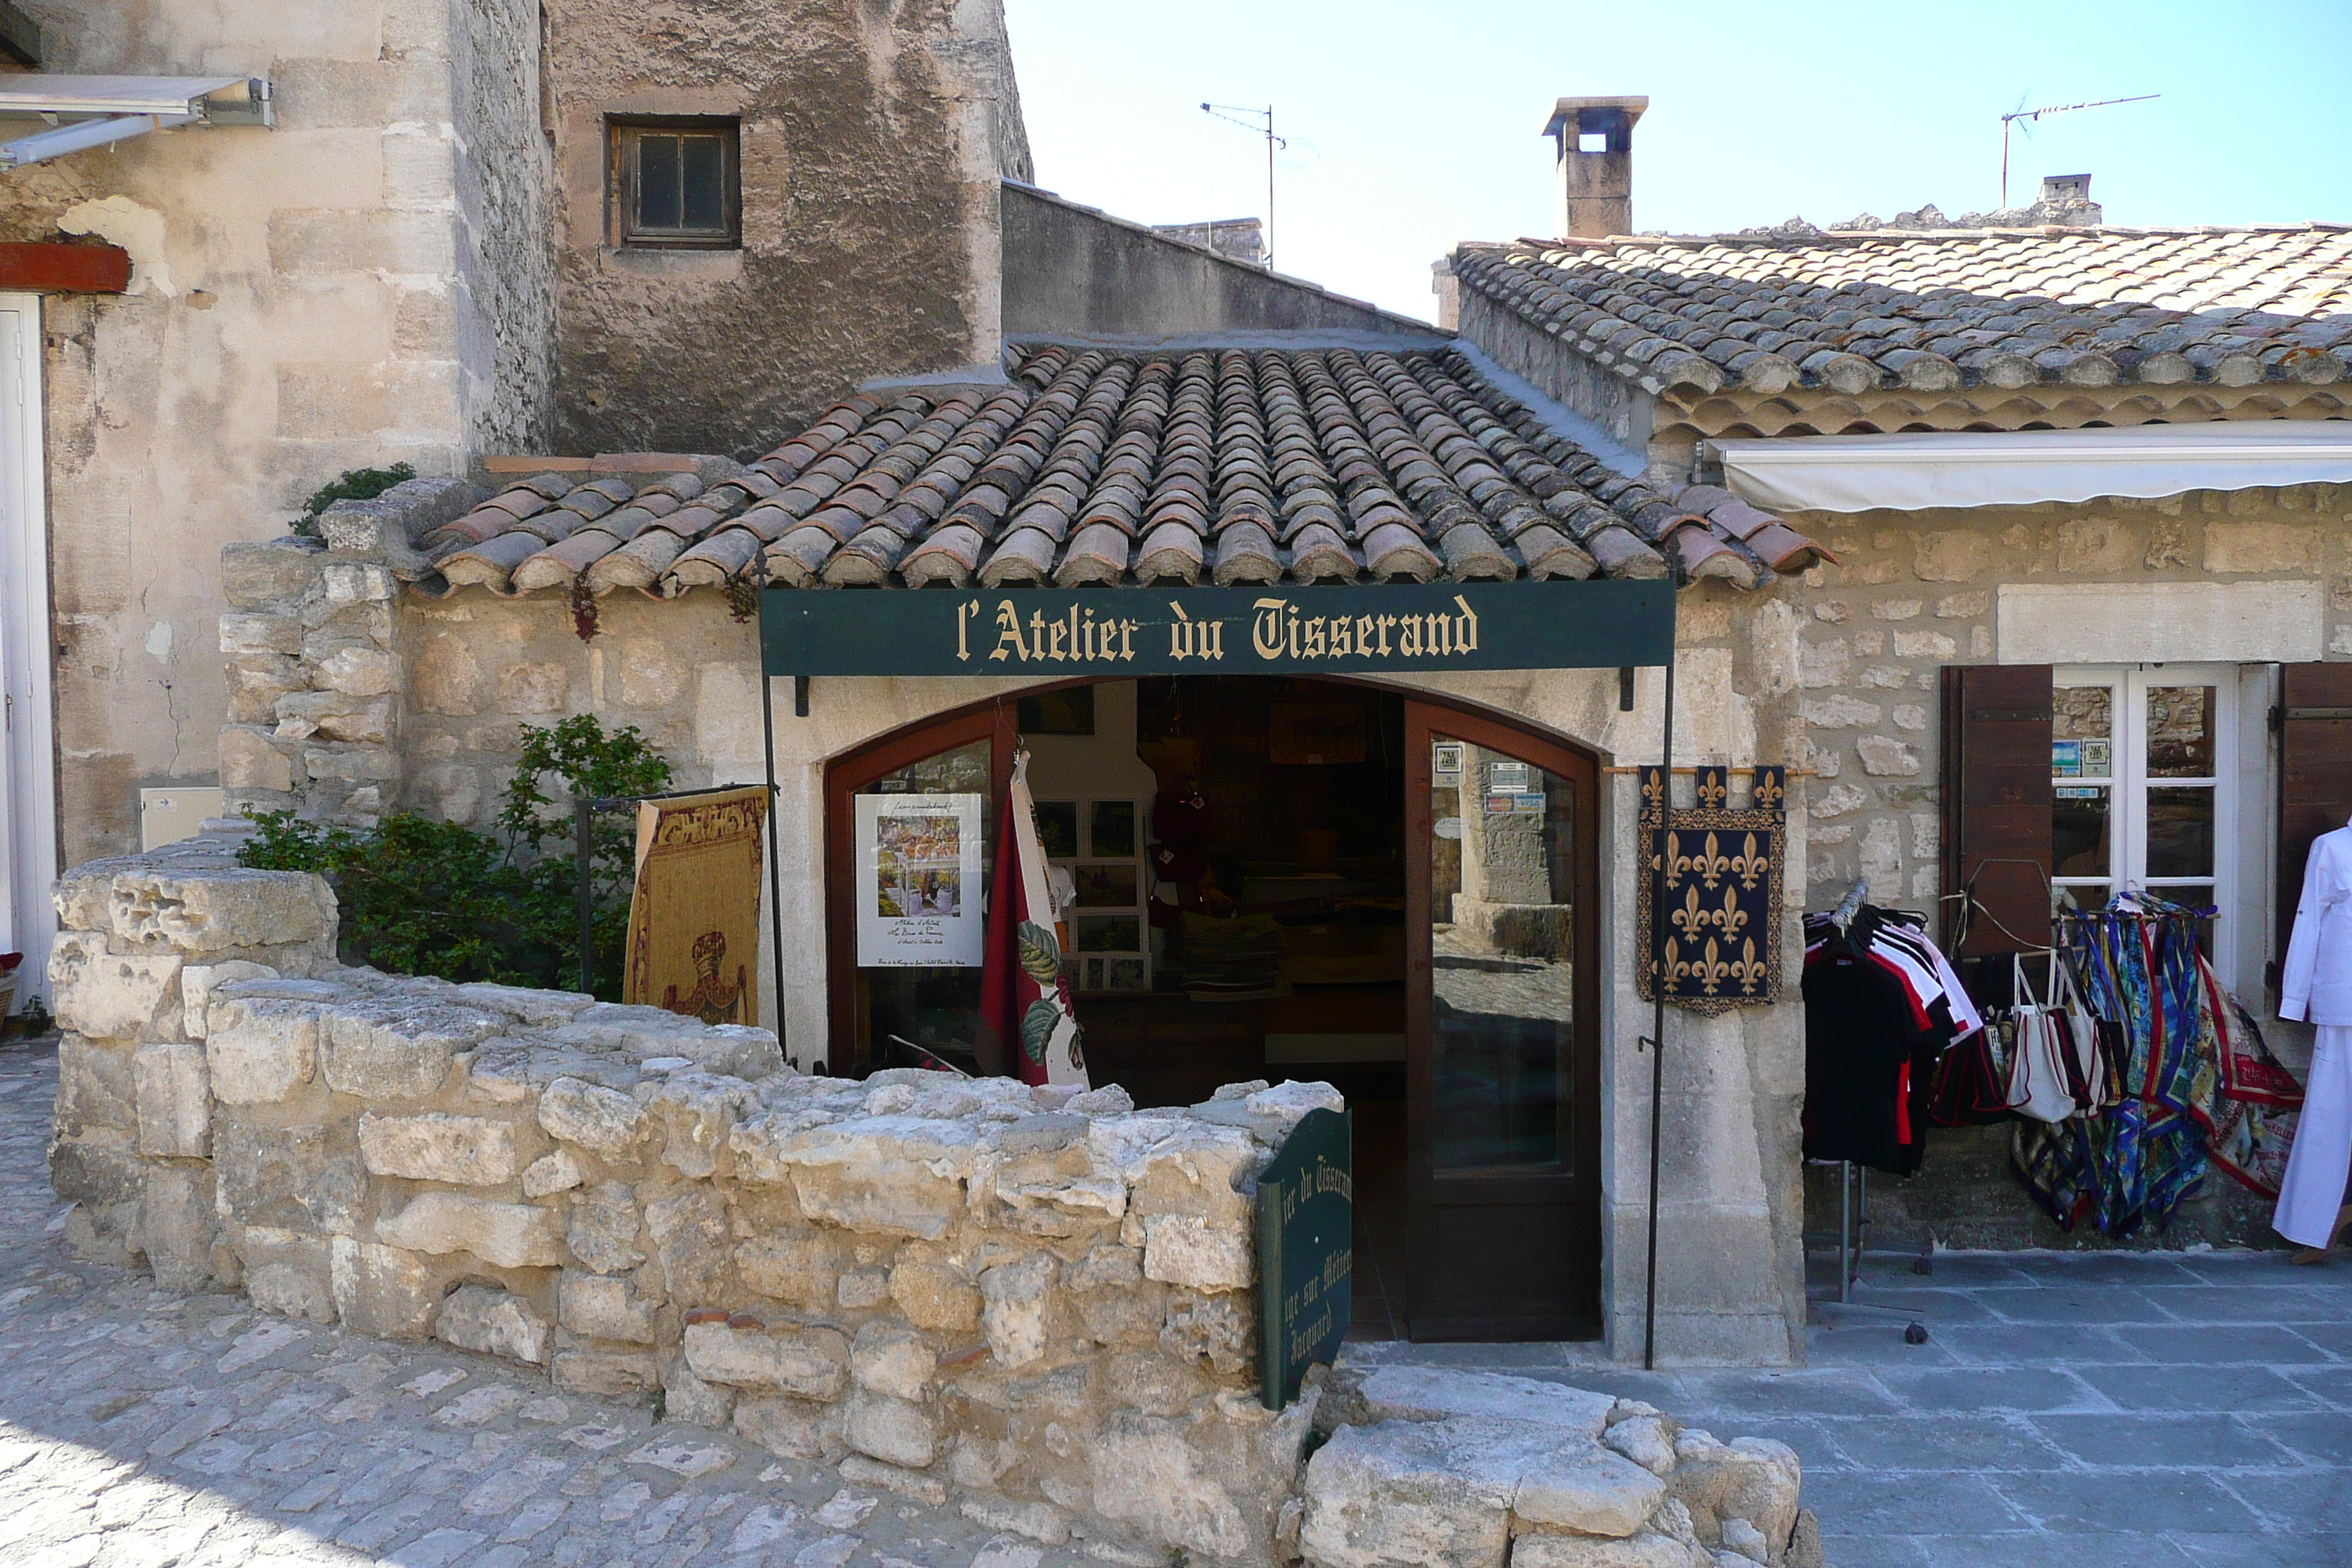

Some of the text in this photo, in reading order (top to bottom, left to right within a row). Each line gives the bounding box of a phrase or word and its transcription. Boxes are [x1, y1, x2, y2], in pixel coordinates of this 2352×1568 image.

[957, 594, 1478, 662] l'Atelier du Tisserand
[1300, 1166, 1312, 1204] du
[1303, 1275, 1319, 1308] sur
[1291, 1300, 1332, 1366] Jacquard
